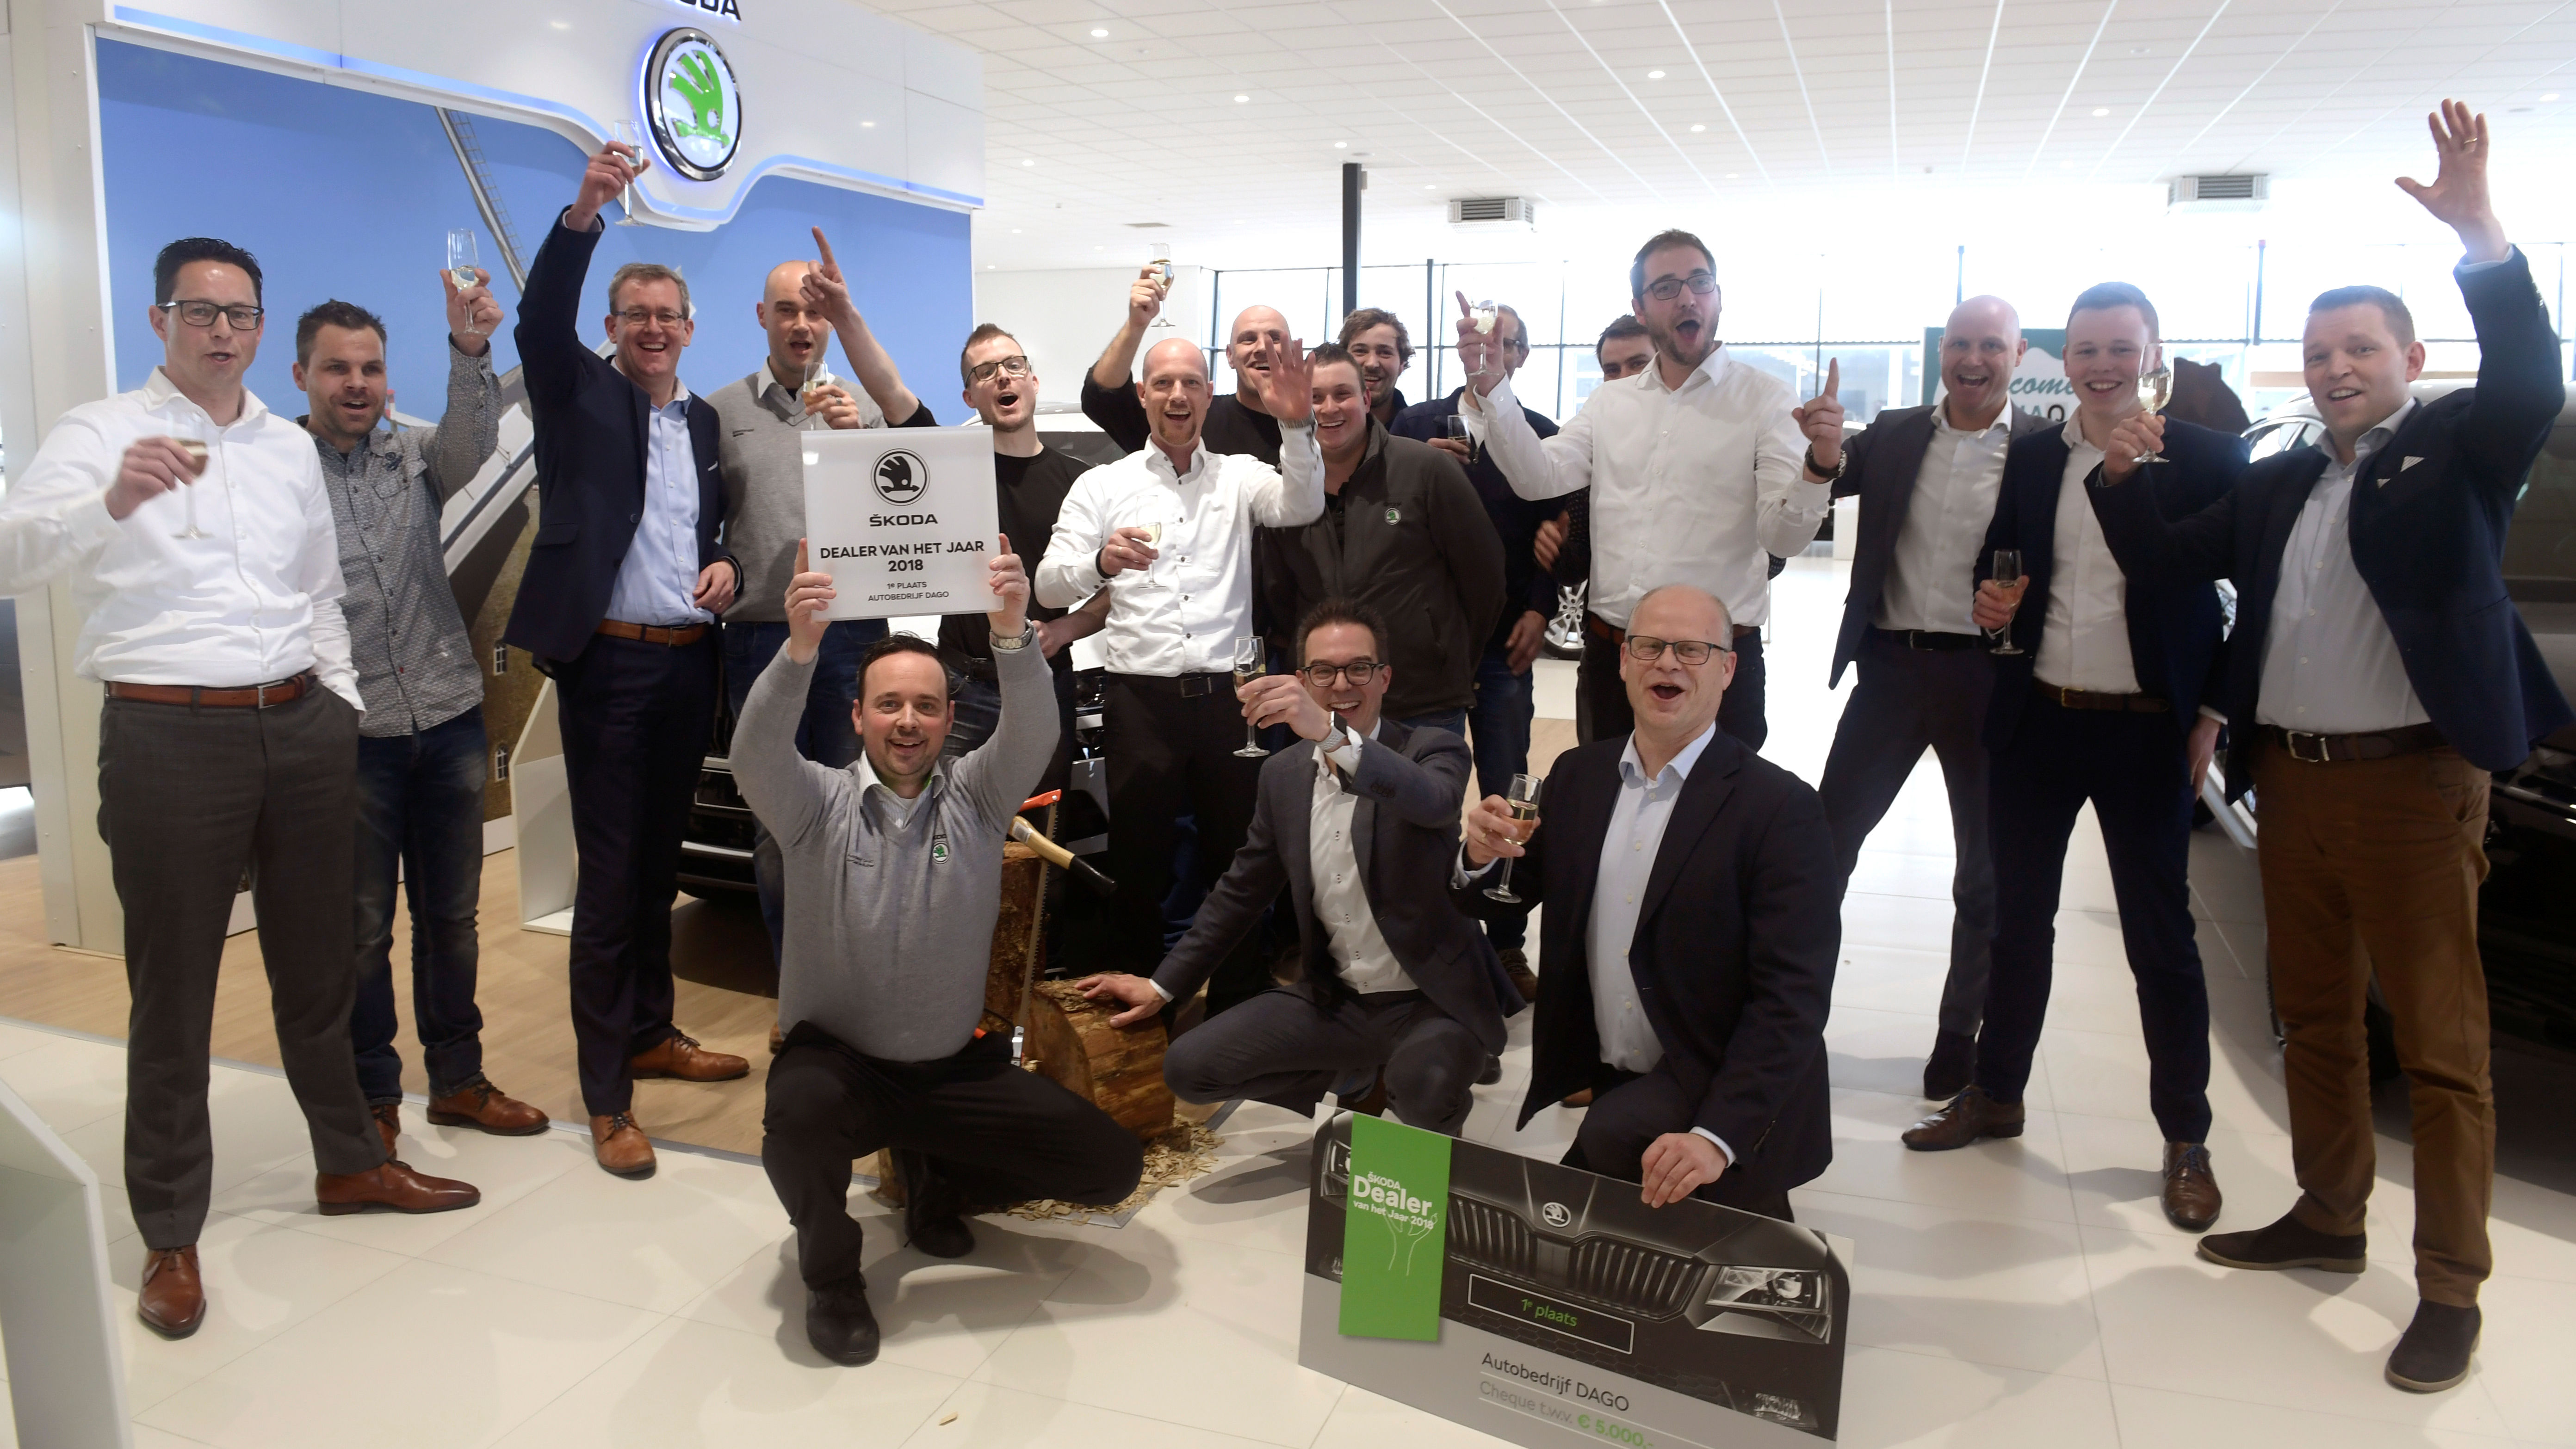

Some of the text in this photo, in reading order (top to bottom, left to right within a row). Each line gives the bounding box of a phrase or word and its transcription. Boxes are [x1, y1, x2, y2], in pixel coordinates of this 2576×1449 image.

[869, 513, 938, 527] ŠKODA
[820, 541, 985, 559] DEALER VAN HET JAAR
[888, 559, 924, 572] 2018
[868, 592, 924, 601] AUTOBEDRIJF
[1367, 1171, 1401, 1190] ŠKODA
[1353, 1175, 1433, 1216] Dealer
[1353, 1200, 1434, 1230] van het Jaar 2018
[1535, 1305, 1578, 1327] plaats
[1481, 1352, 1629, 1412] Autobedrijf DAGO
[1480, 1381, 1536, 1409] Cheque
